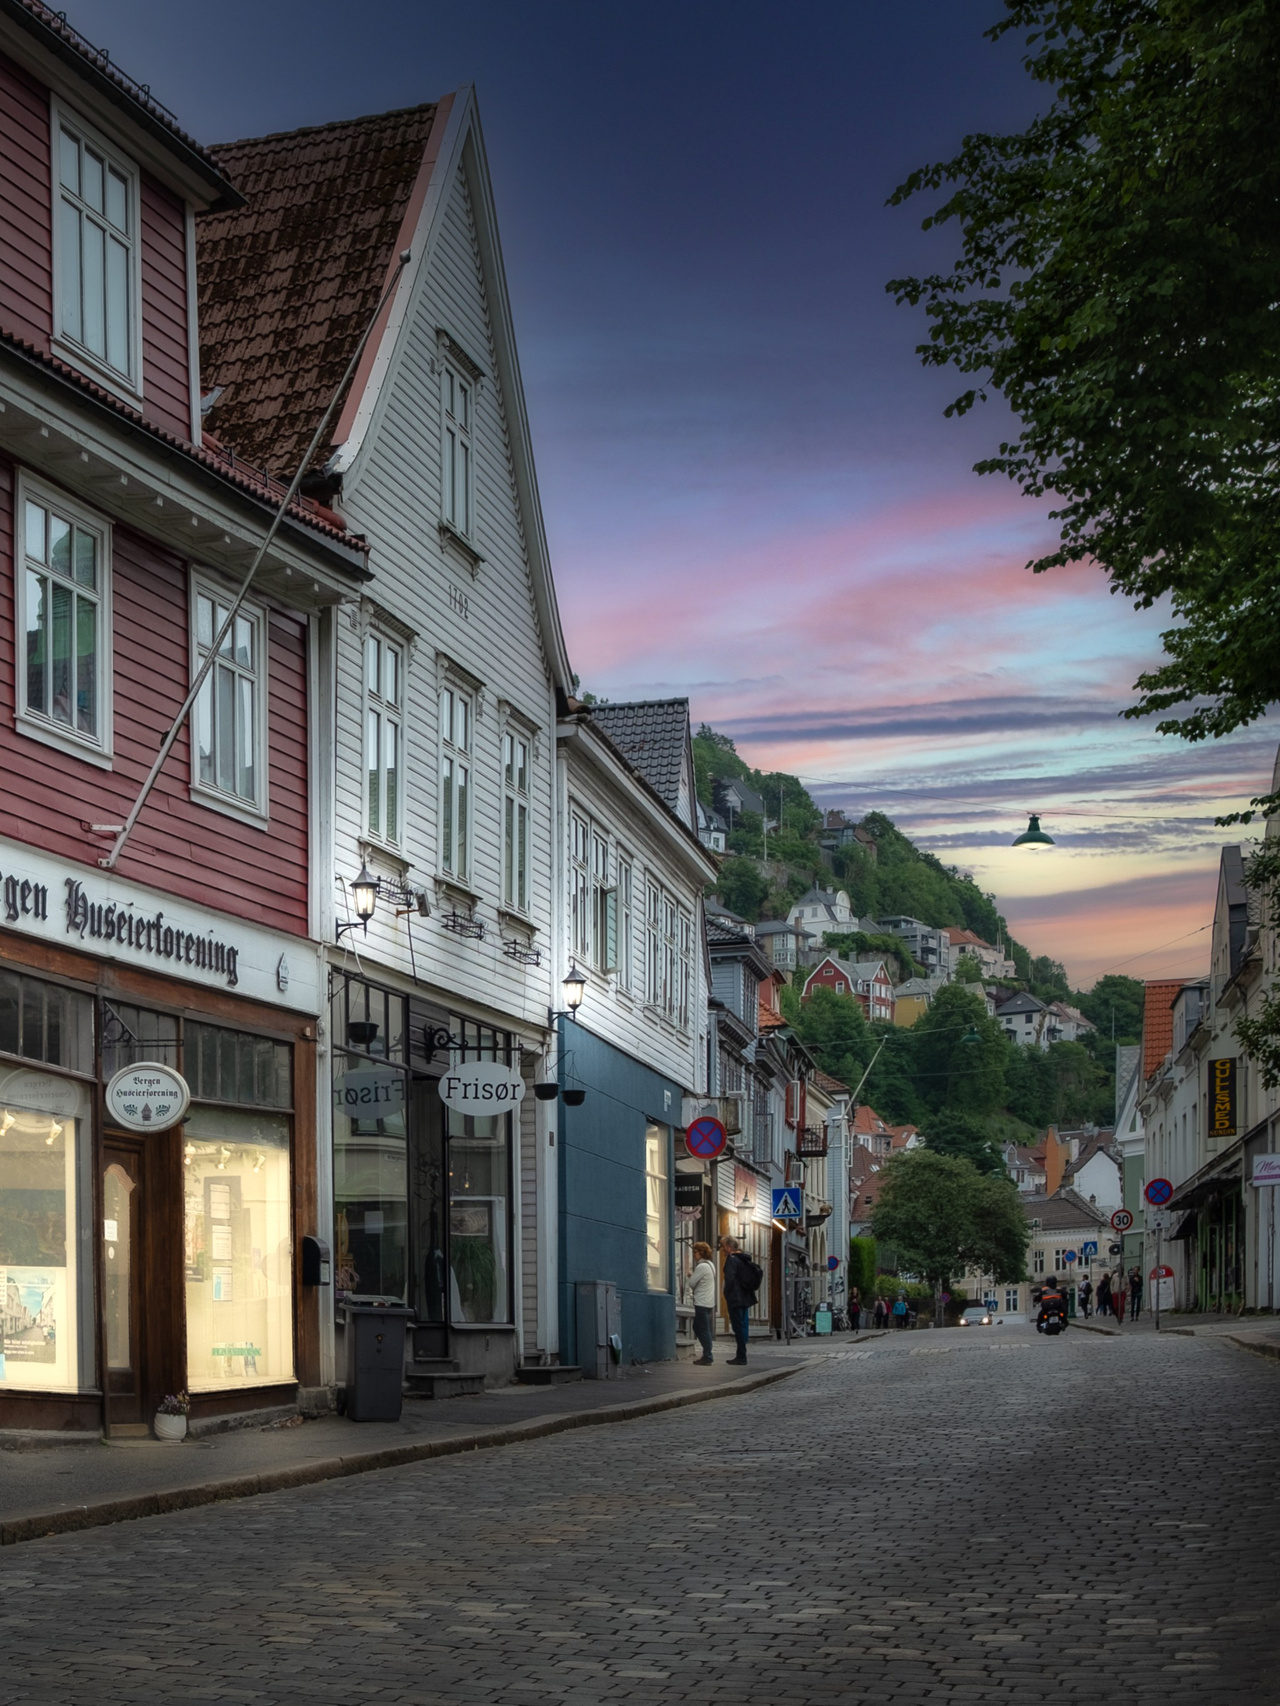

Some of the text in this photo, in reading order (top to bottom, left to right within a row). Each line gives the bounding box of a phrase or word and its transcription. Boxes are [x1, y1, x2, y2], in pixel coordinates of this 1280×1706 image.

[64, 876, 239, 987] Huseierforening
[115, 1075, 180, 1100] Bergen Huseierforening
[444, 1077, 521, 1102] Frisør
[1214, 1059, 1231, 1129] GULLSMED
[1115, 1214, 1130, 1226] 30
